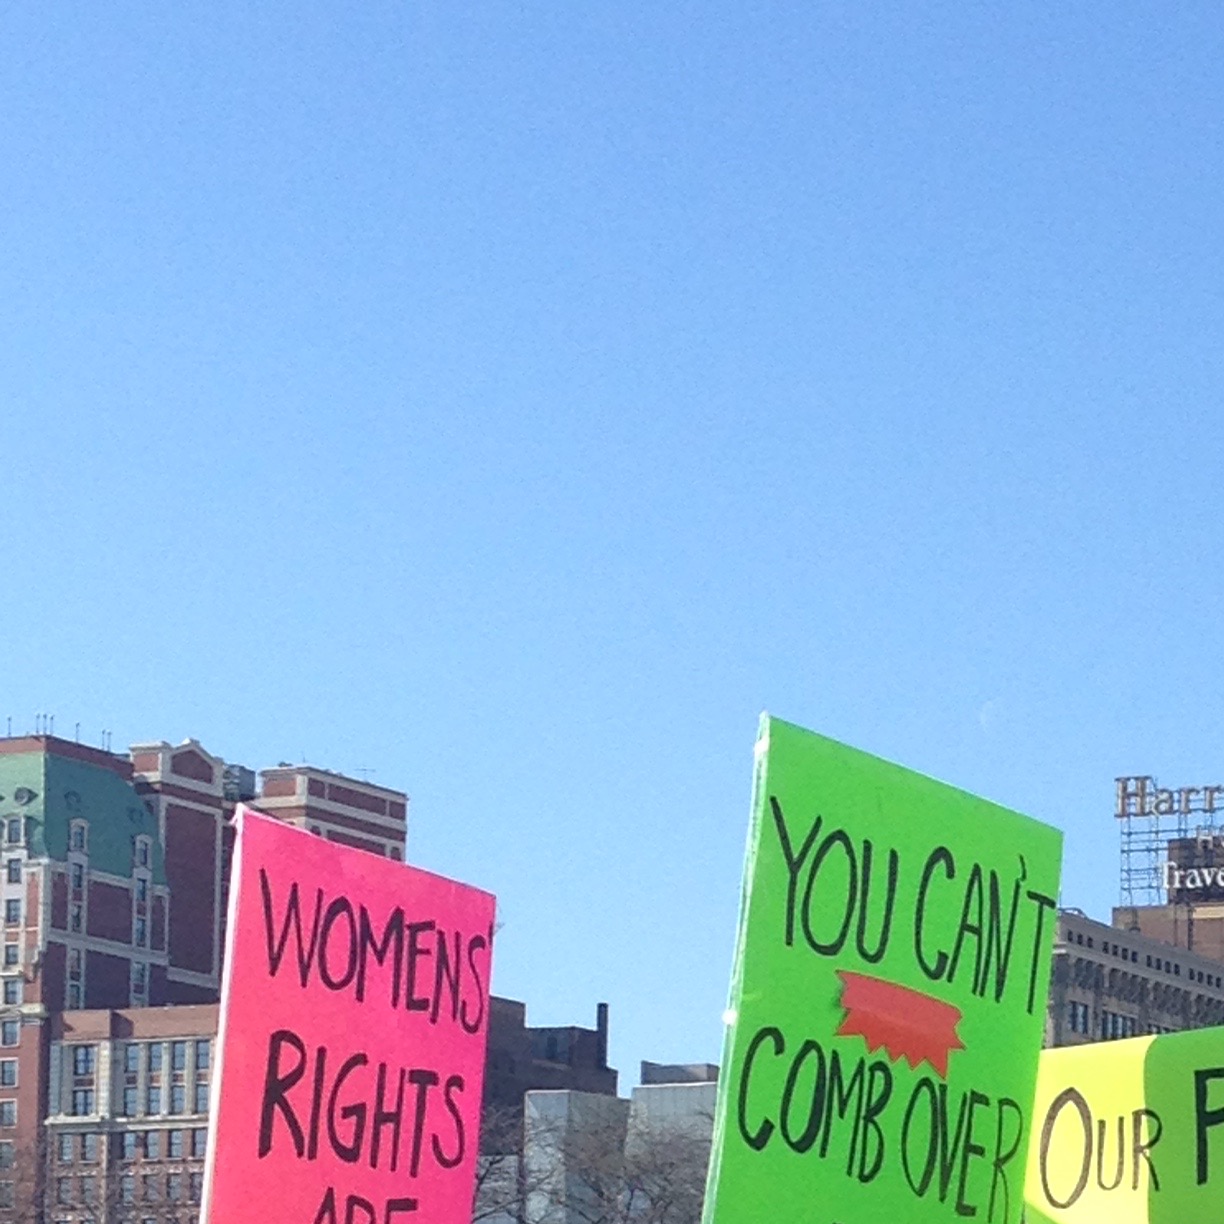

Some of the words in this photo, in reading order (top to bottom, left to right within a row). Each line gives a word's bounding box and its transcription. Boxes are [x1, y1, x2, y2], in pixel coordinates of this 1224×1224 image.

[769, 796, 899, 963] YOU
[914, 846, 1058, 1015] CAN'T
[258, 1030, 465, 1177] RIGHTS
[738, 1026, 893, 1184] COMB
[1039, 1087, 1163, 1209] OUR
